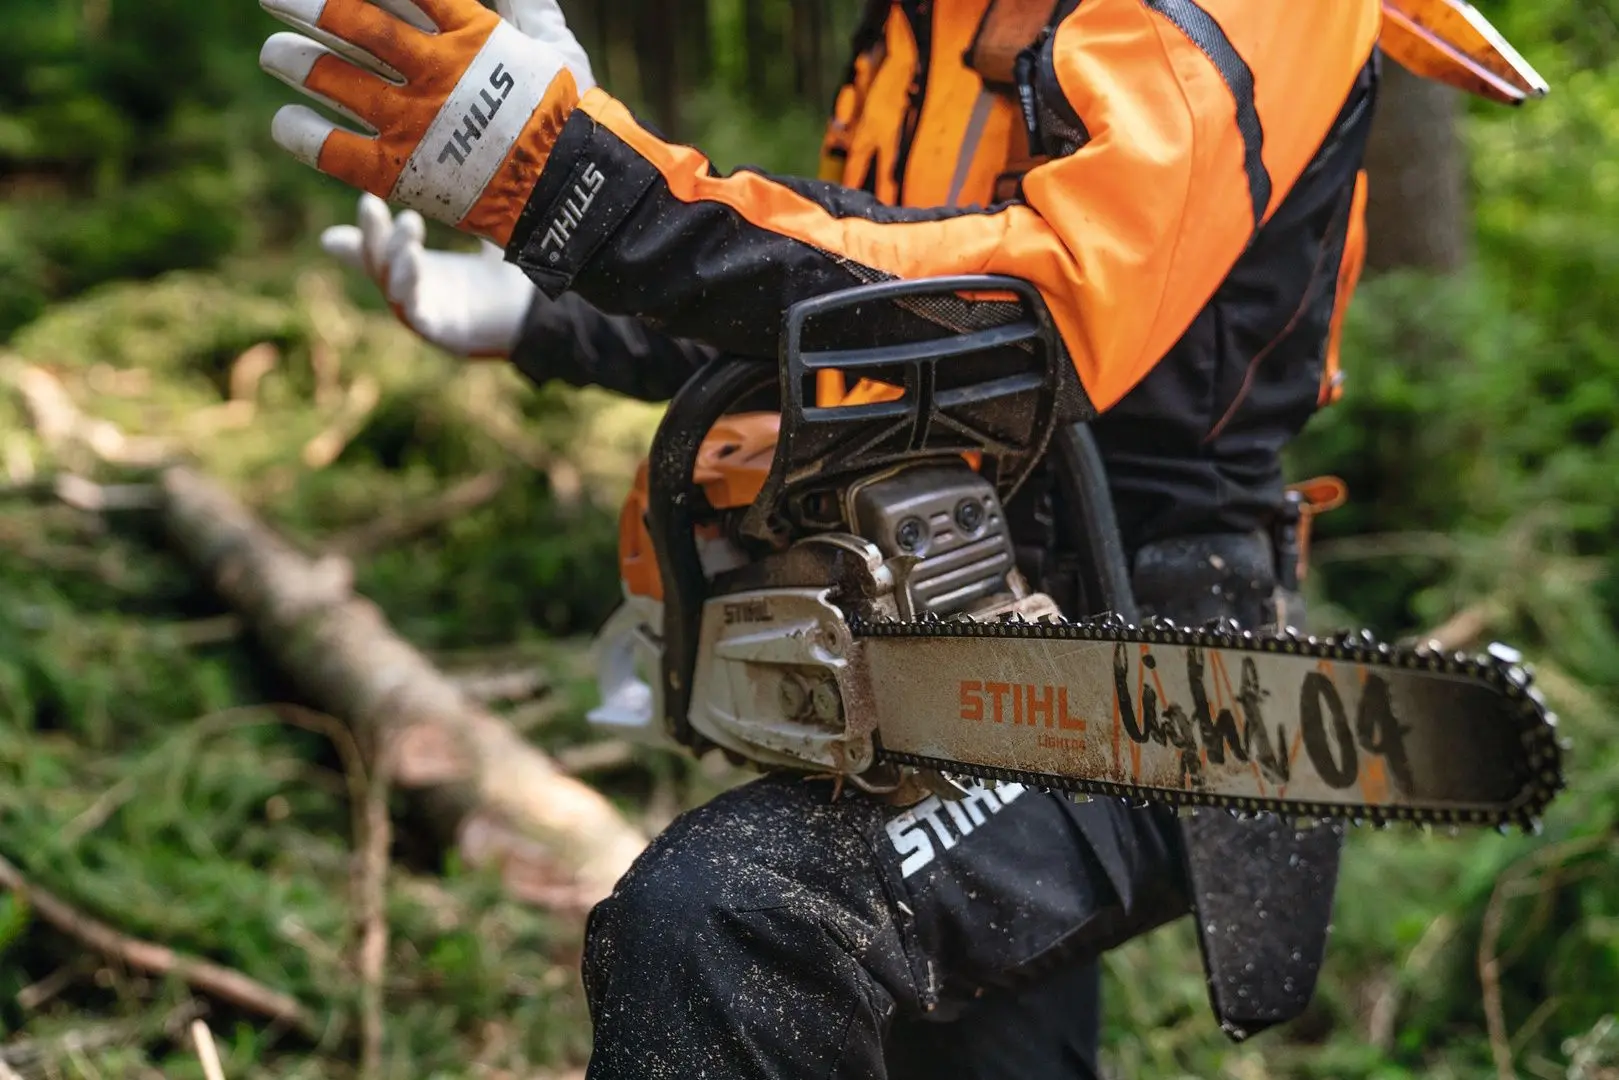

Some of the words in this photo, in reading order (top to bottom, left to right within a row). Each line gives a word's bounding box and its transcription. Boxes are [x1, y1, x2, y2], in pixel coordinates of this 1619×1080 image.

[437, 63, 515, 166] STIHL
[723, 600, 775, 624] STIHL
[960, 679, 1087, 731] STIHL
[1300, 671, 1414, 797] 04
